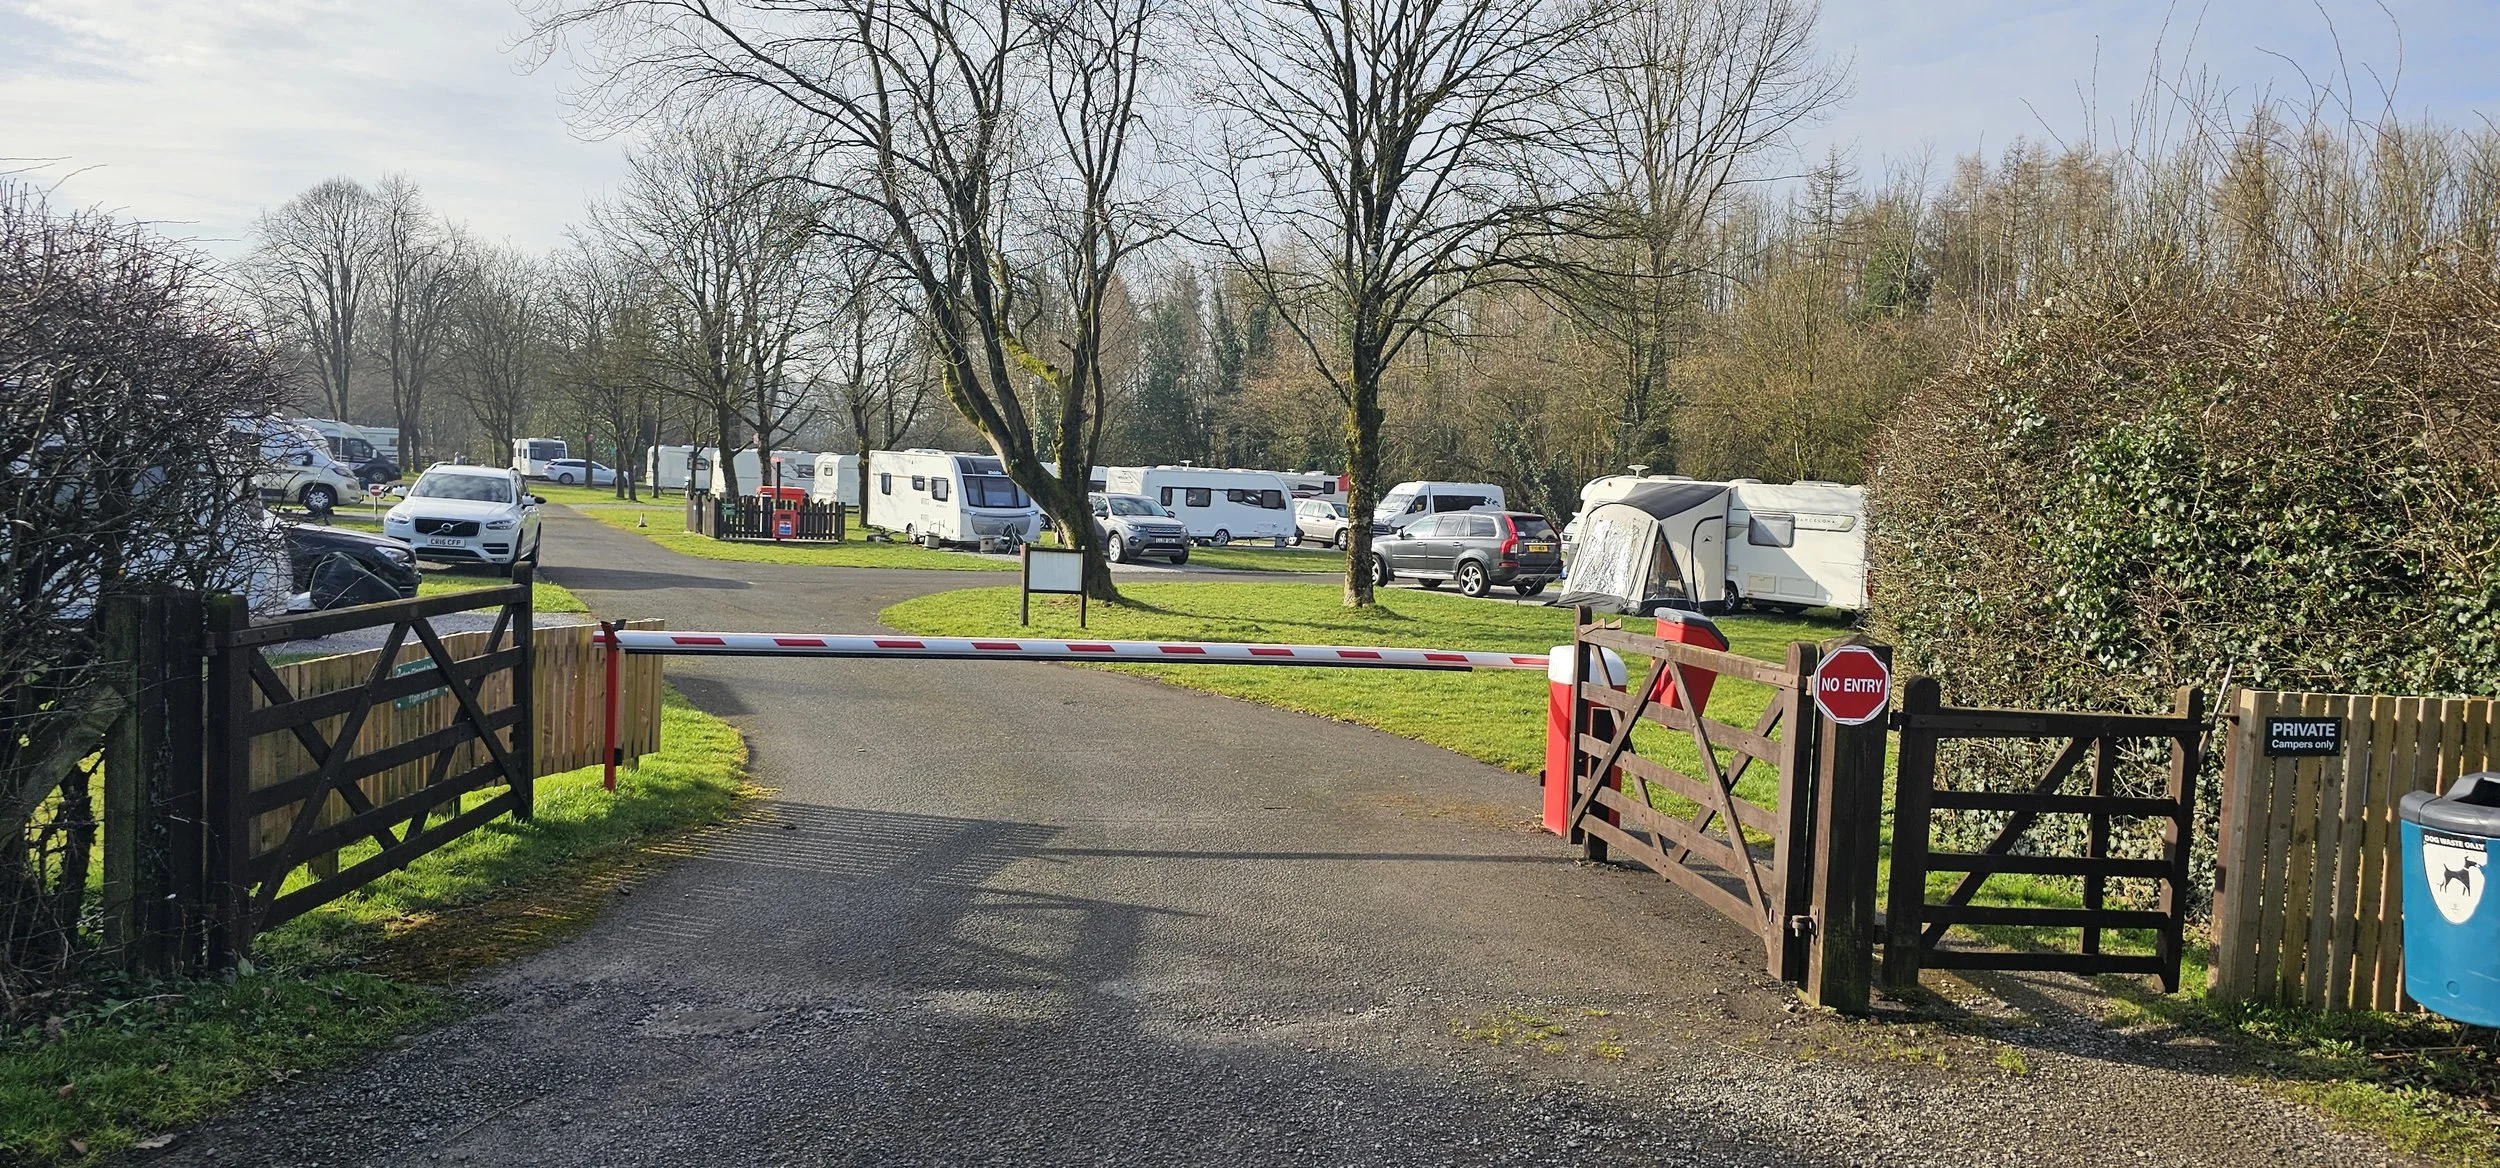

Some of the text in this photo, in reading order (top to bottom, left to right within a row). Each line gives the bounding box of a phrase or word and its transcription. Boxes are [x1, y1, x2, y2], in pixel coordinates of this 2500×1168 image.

[1821, 677, 1883, 693] NO ENTRY
[2272, 722, 2336, 737] PRIVATE
[2271, 739, 2335, 750] Campers only
[2424, 834, 2440, 844] DOG
[2440, 837, 2464, 848] WASTE
